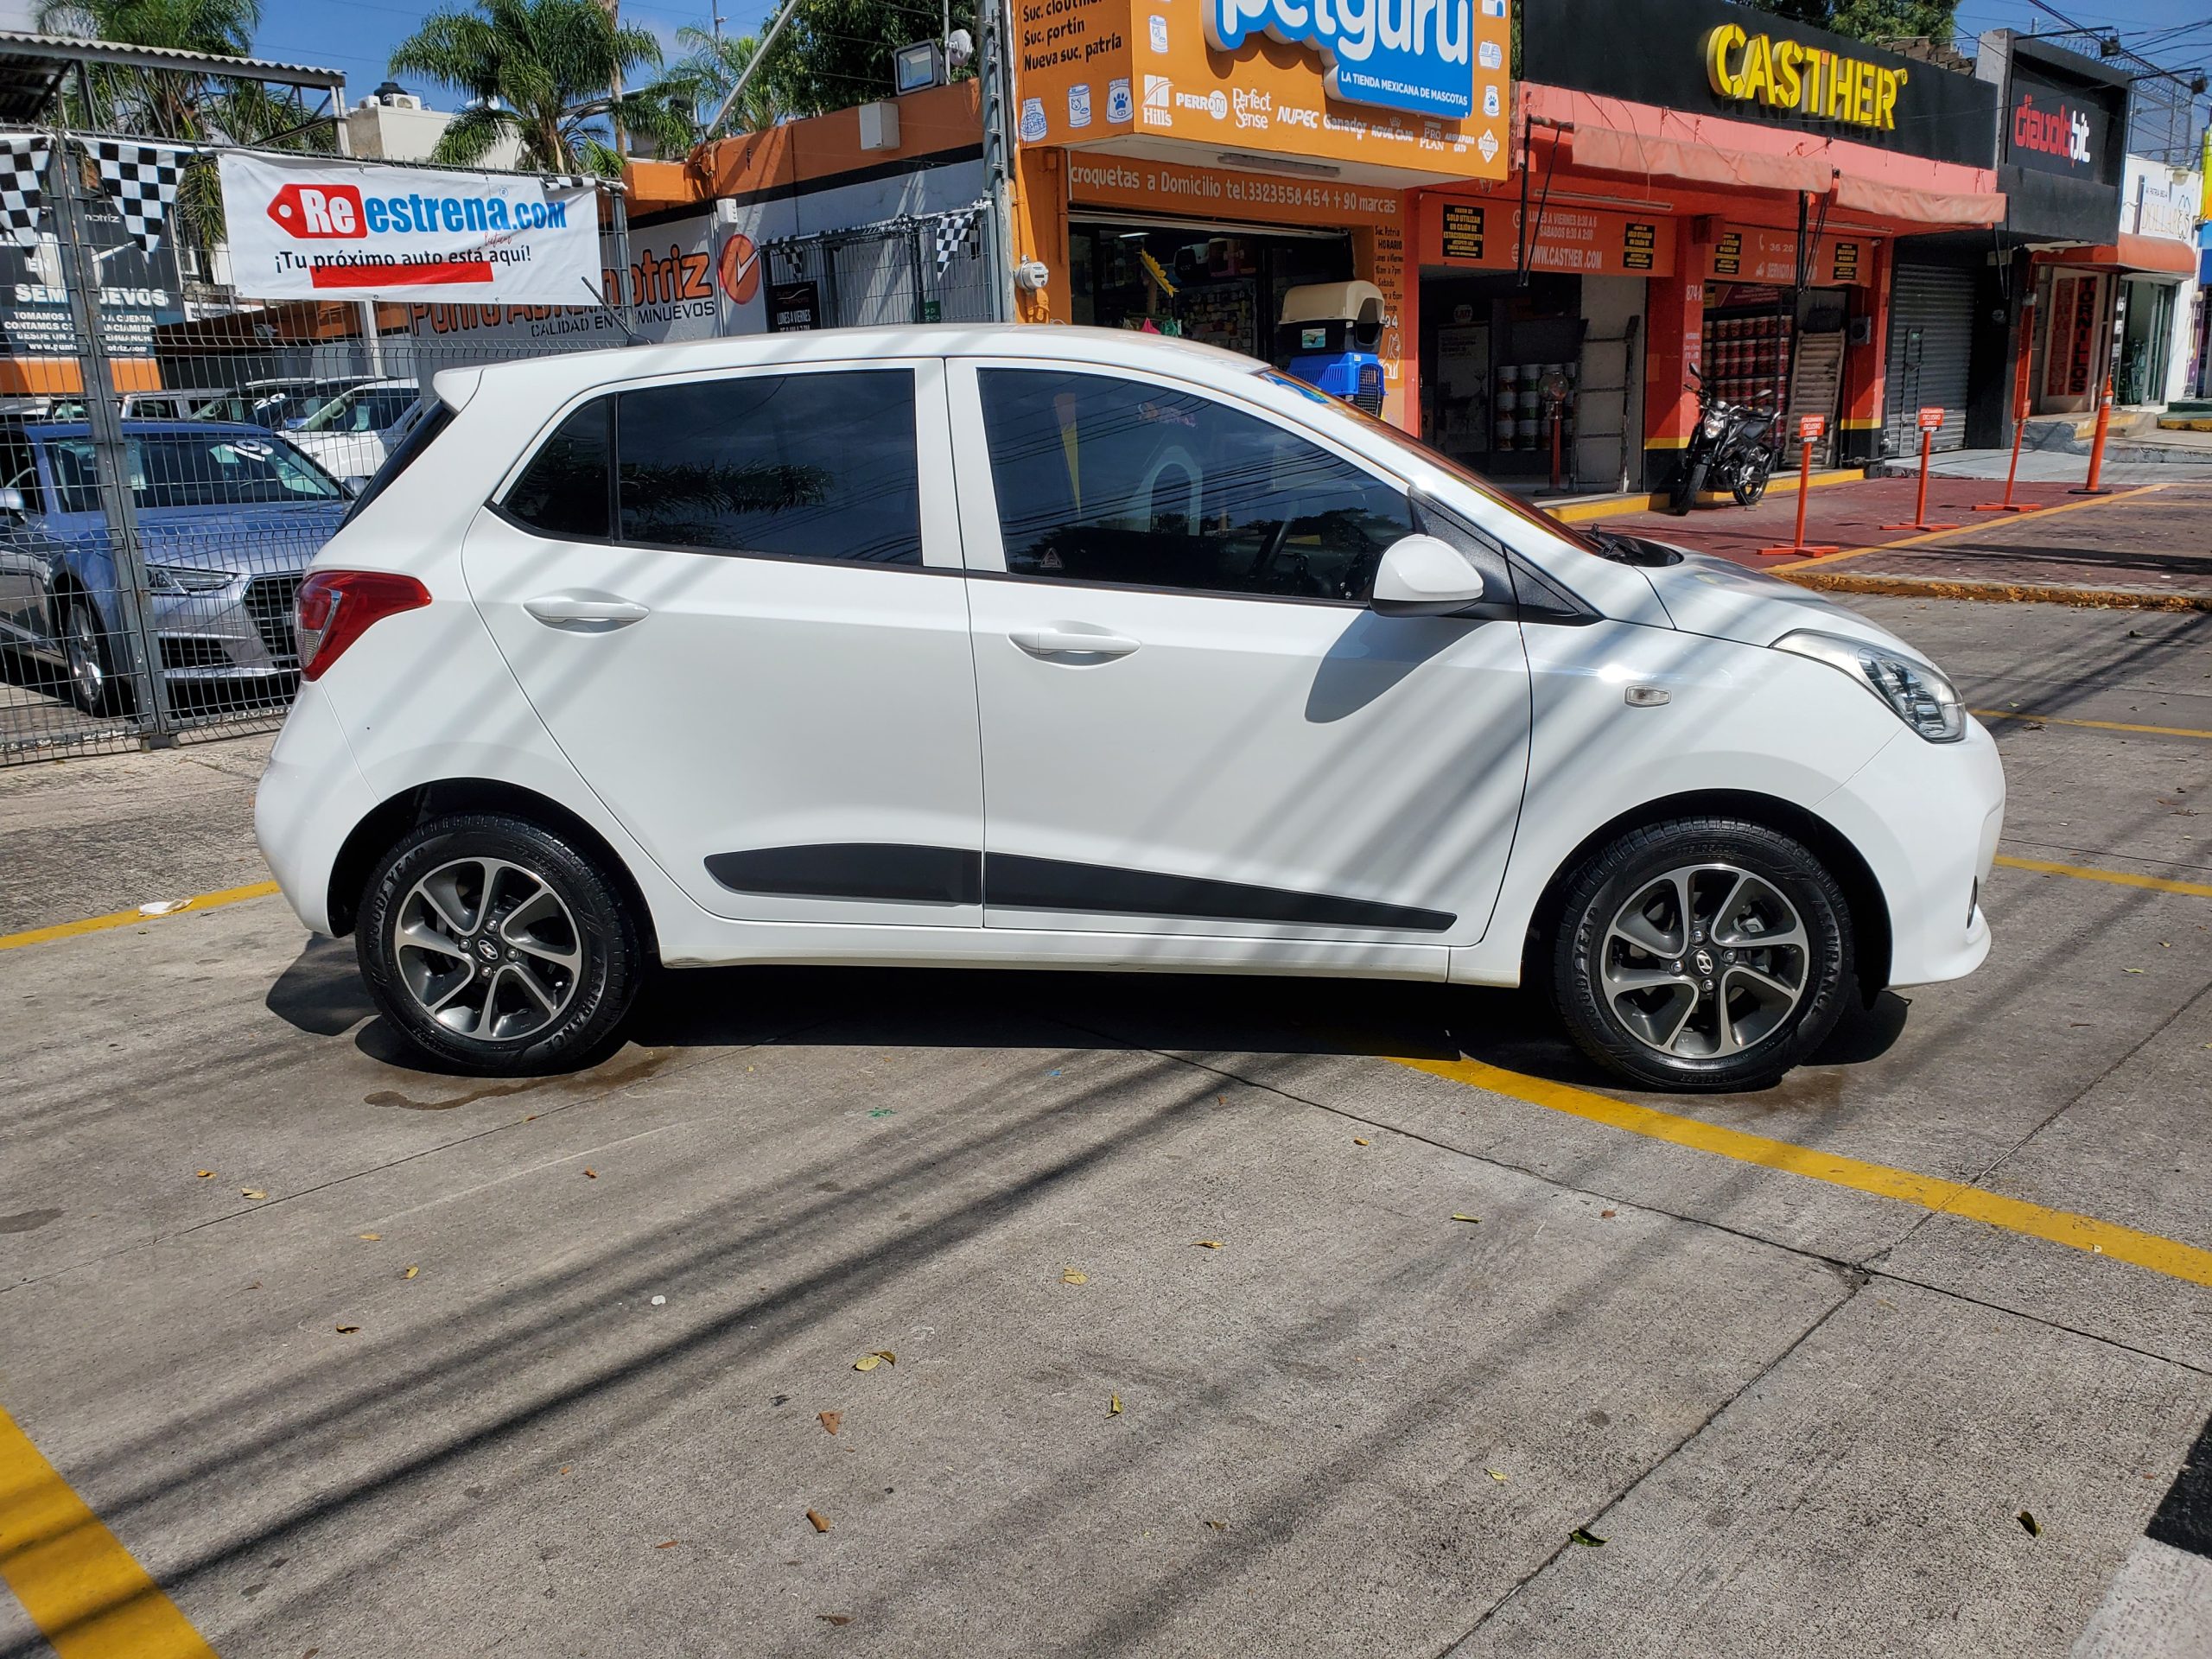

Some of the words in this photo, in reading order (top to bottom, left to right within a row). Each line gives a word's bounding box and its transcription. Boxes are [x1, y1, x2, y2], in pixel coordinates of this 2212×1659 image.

[1023, 5, 1043, 22] Suc.
[1024, 29, 1044, 47] Suc.
[1024, 54, 1058, 72] Nueva
[1060, 47, 1082, 62] suc.
[1341, 71, 1351, 83] LA
[1352, 73, 1381, 89] TIENDA
[1382, 79, 1419, 97] MEXICANA
[1420, 87, 1430, 99] DE
[1430, 90, 1467, 105] MASCOTAS
[1707, 23, 1898, 130] CASTHER
[1232, 87, 1272, 111] Perfect
[1236, 105, 1268, 129] Sense
[1276, 105, 1319, 128] NUPEC
[1419, 138, 1444, 151] PLAN
[1424, 127, 1441, 141] PRO
[1071, 165, 1140, 189] croquetas
[1147, 173, 1156, 189] a
[1161, 171, 1221, 199] Domicilio
[1344, 192, 1357, 210] 90
[1359, 195, 1396, 214] marcas
[1378, 238, 1402, 250] HORARIO
[275, 251, 308, 273] ¡Tu
[314, 250, 395, 272] próximo
[403, 252, 442, 266] auto
[448, 247, 484, 264] está
[489, 245, 531, 267] aquí!
[531, 316, 589, 337] CALIDAD
[594, 314, 613, 330] EN
[2068, 276, 2098, 393] TORNILLOS
